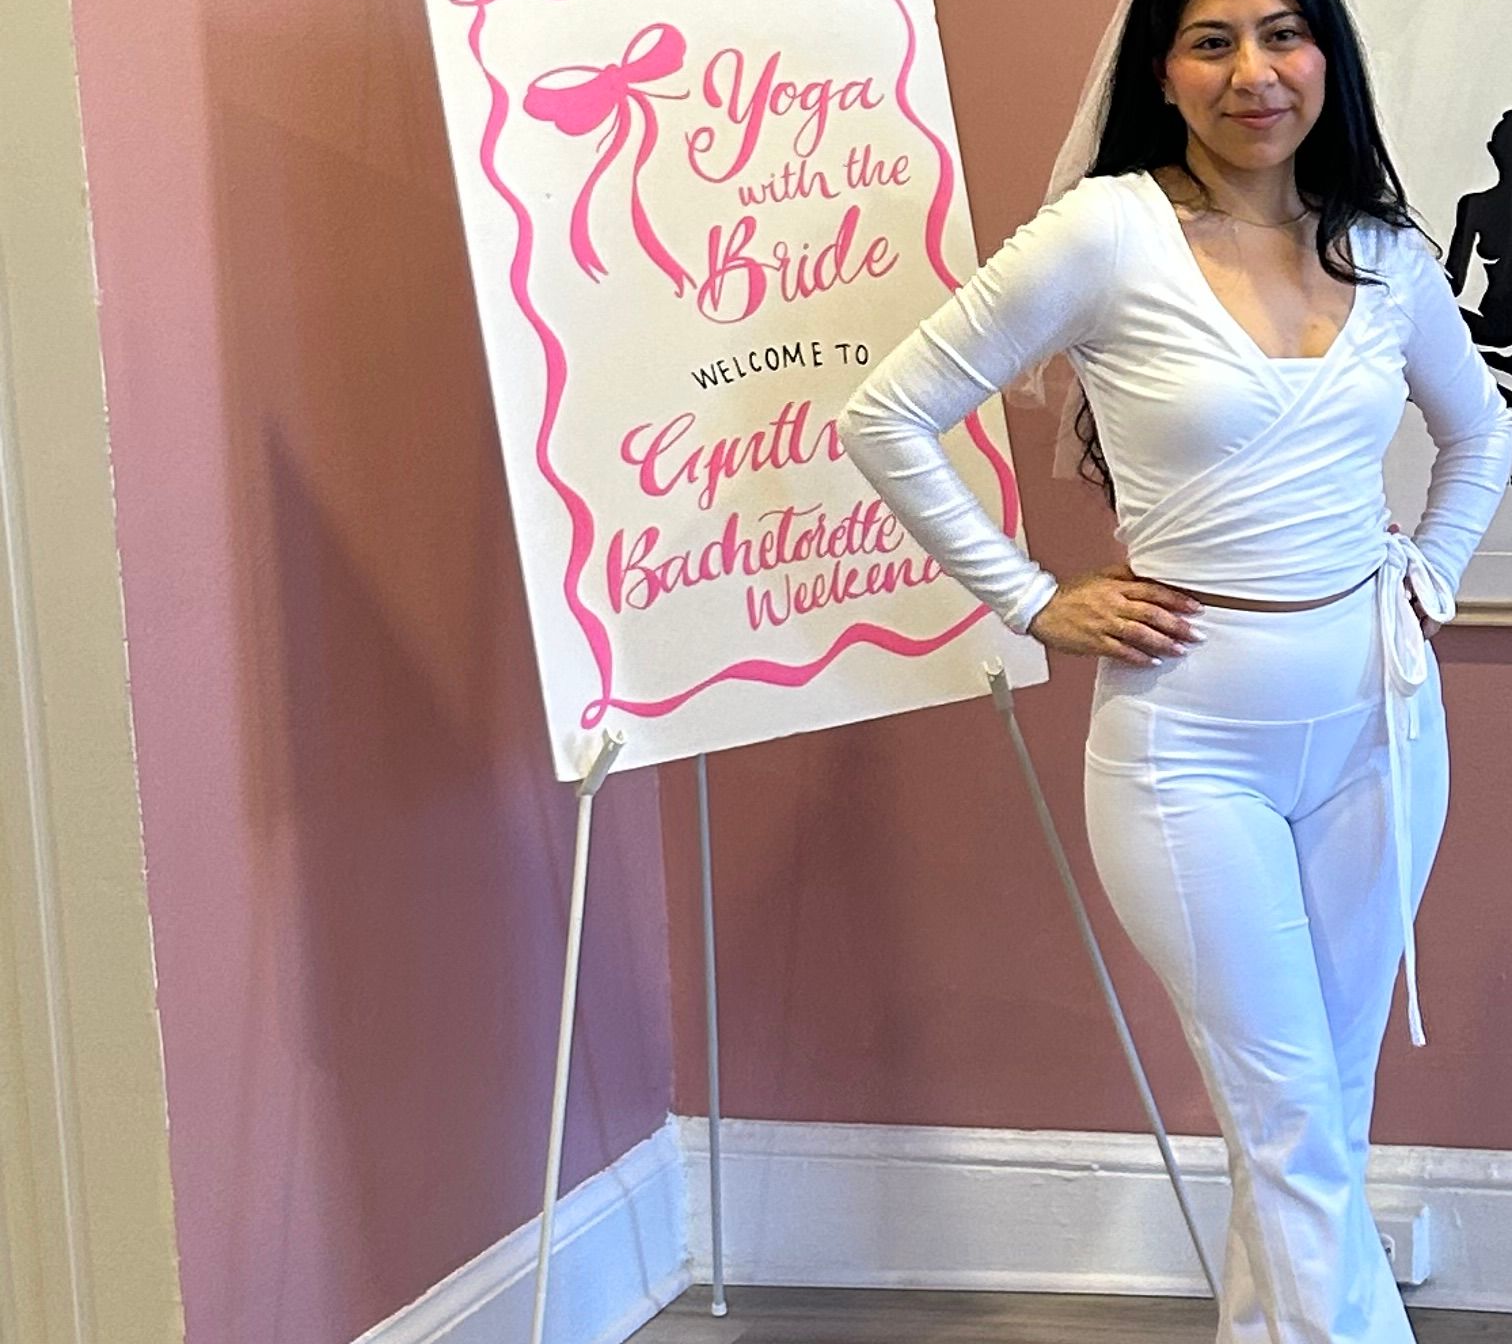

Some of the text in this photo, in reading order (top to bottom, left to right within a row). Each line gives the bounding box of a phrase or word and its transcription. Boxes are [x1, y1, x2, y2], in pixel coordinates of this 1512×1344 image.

[685, 48, 885, 183] Yoga
[738, 144, 911, 206] with the
[697, 205, 900, 324] Bride
[691, 341, 869, 390] WELCOME TO
[620, 400, 847, 510] Cynth
